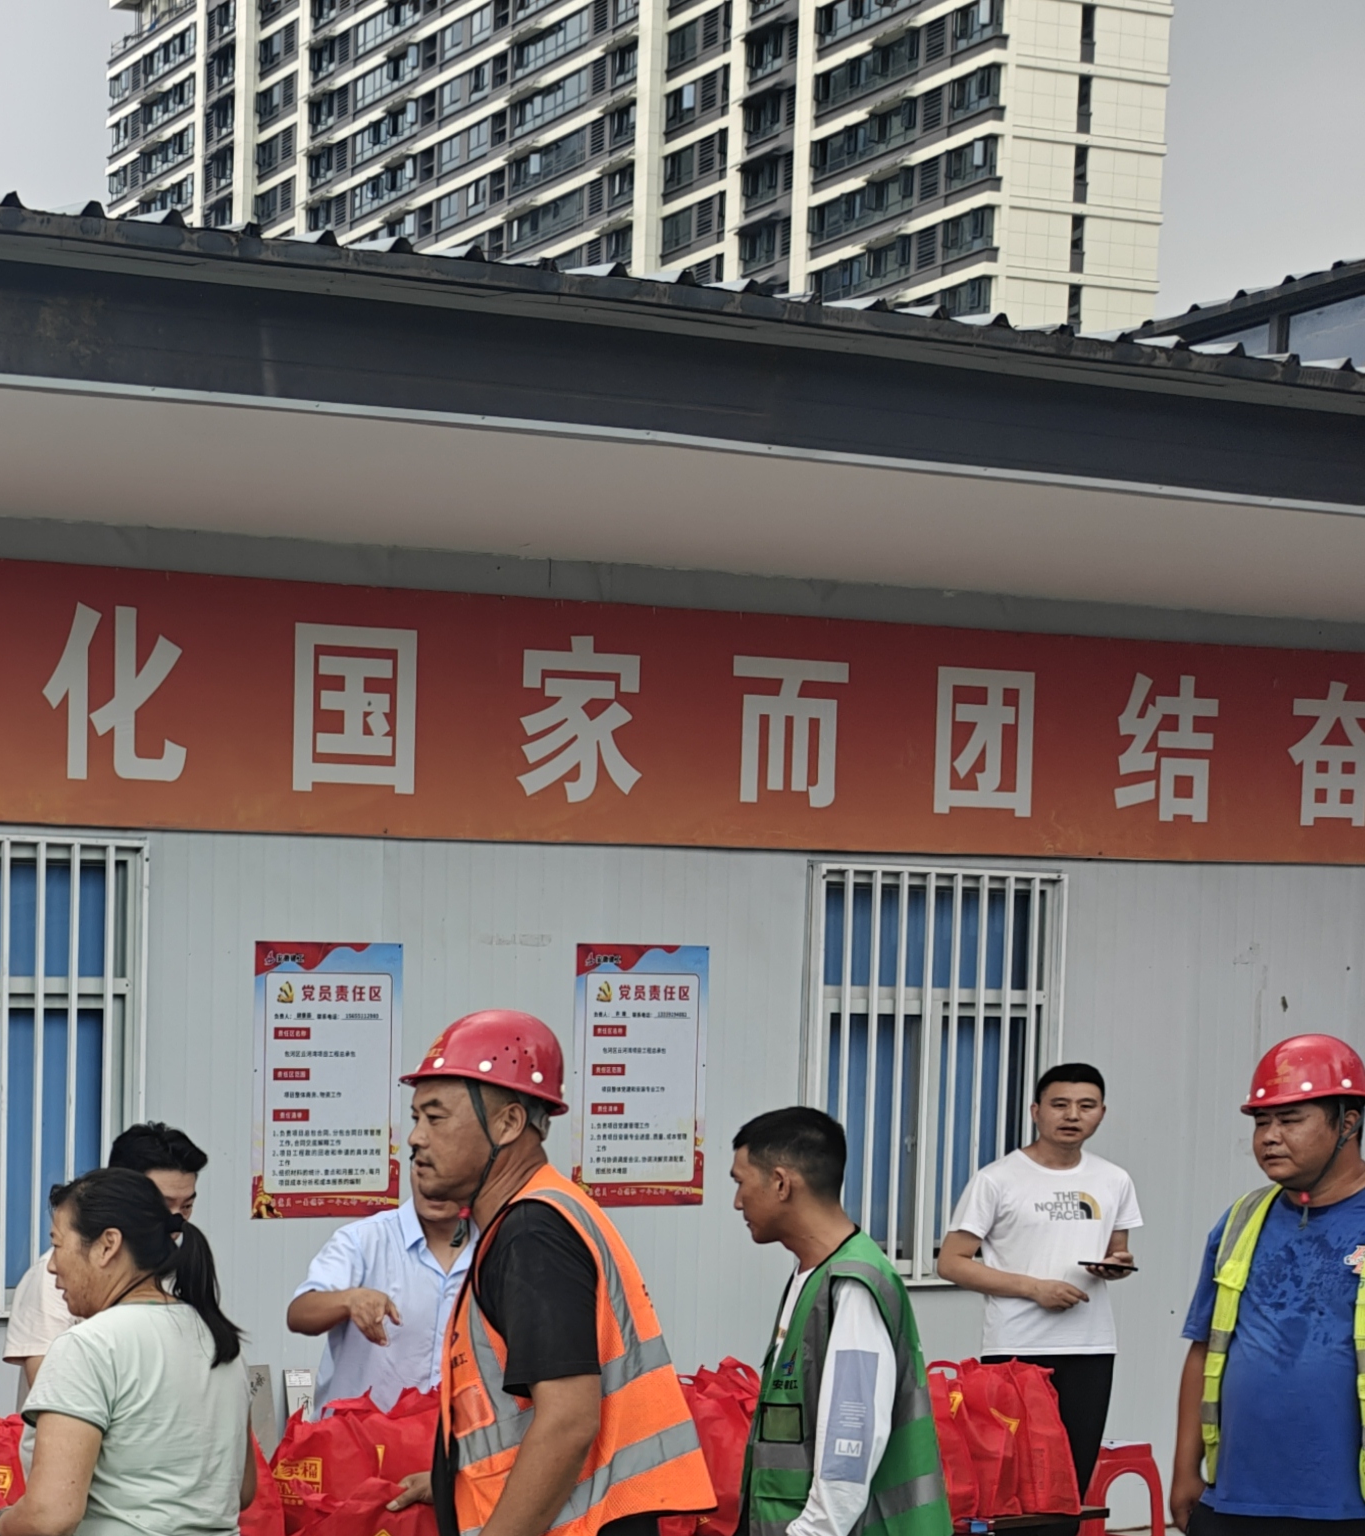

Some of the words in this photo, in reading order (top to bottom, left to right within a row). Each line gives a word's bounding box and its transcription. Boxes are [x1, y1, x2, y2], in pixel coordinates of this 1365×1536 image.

[302, 985, 382, 1002] 党员责任区
[619, 984, 690, 1001] 党员责任区
[1053, 1191, 1078, 1201] THE
[1034, 1201, 1079, 1213] NORTH
[1049, 1210, 1080, 1221] FACE
[837, 1441, 860, 1455] LM
[275, 1462, 318, 1479] 家福
